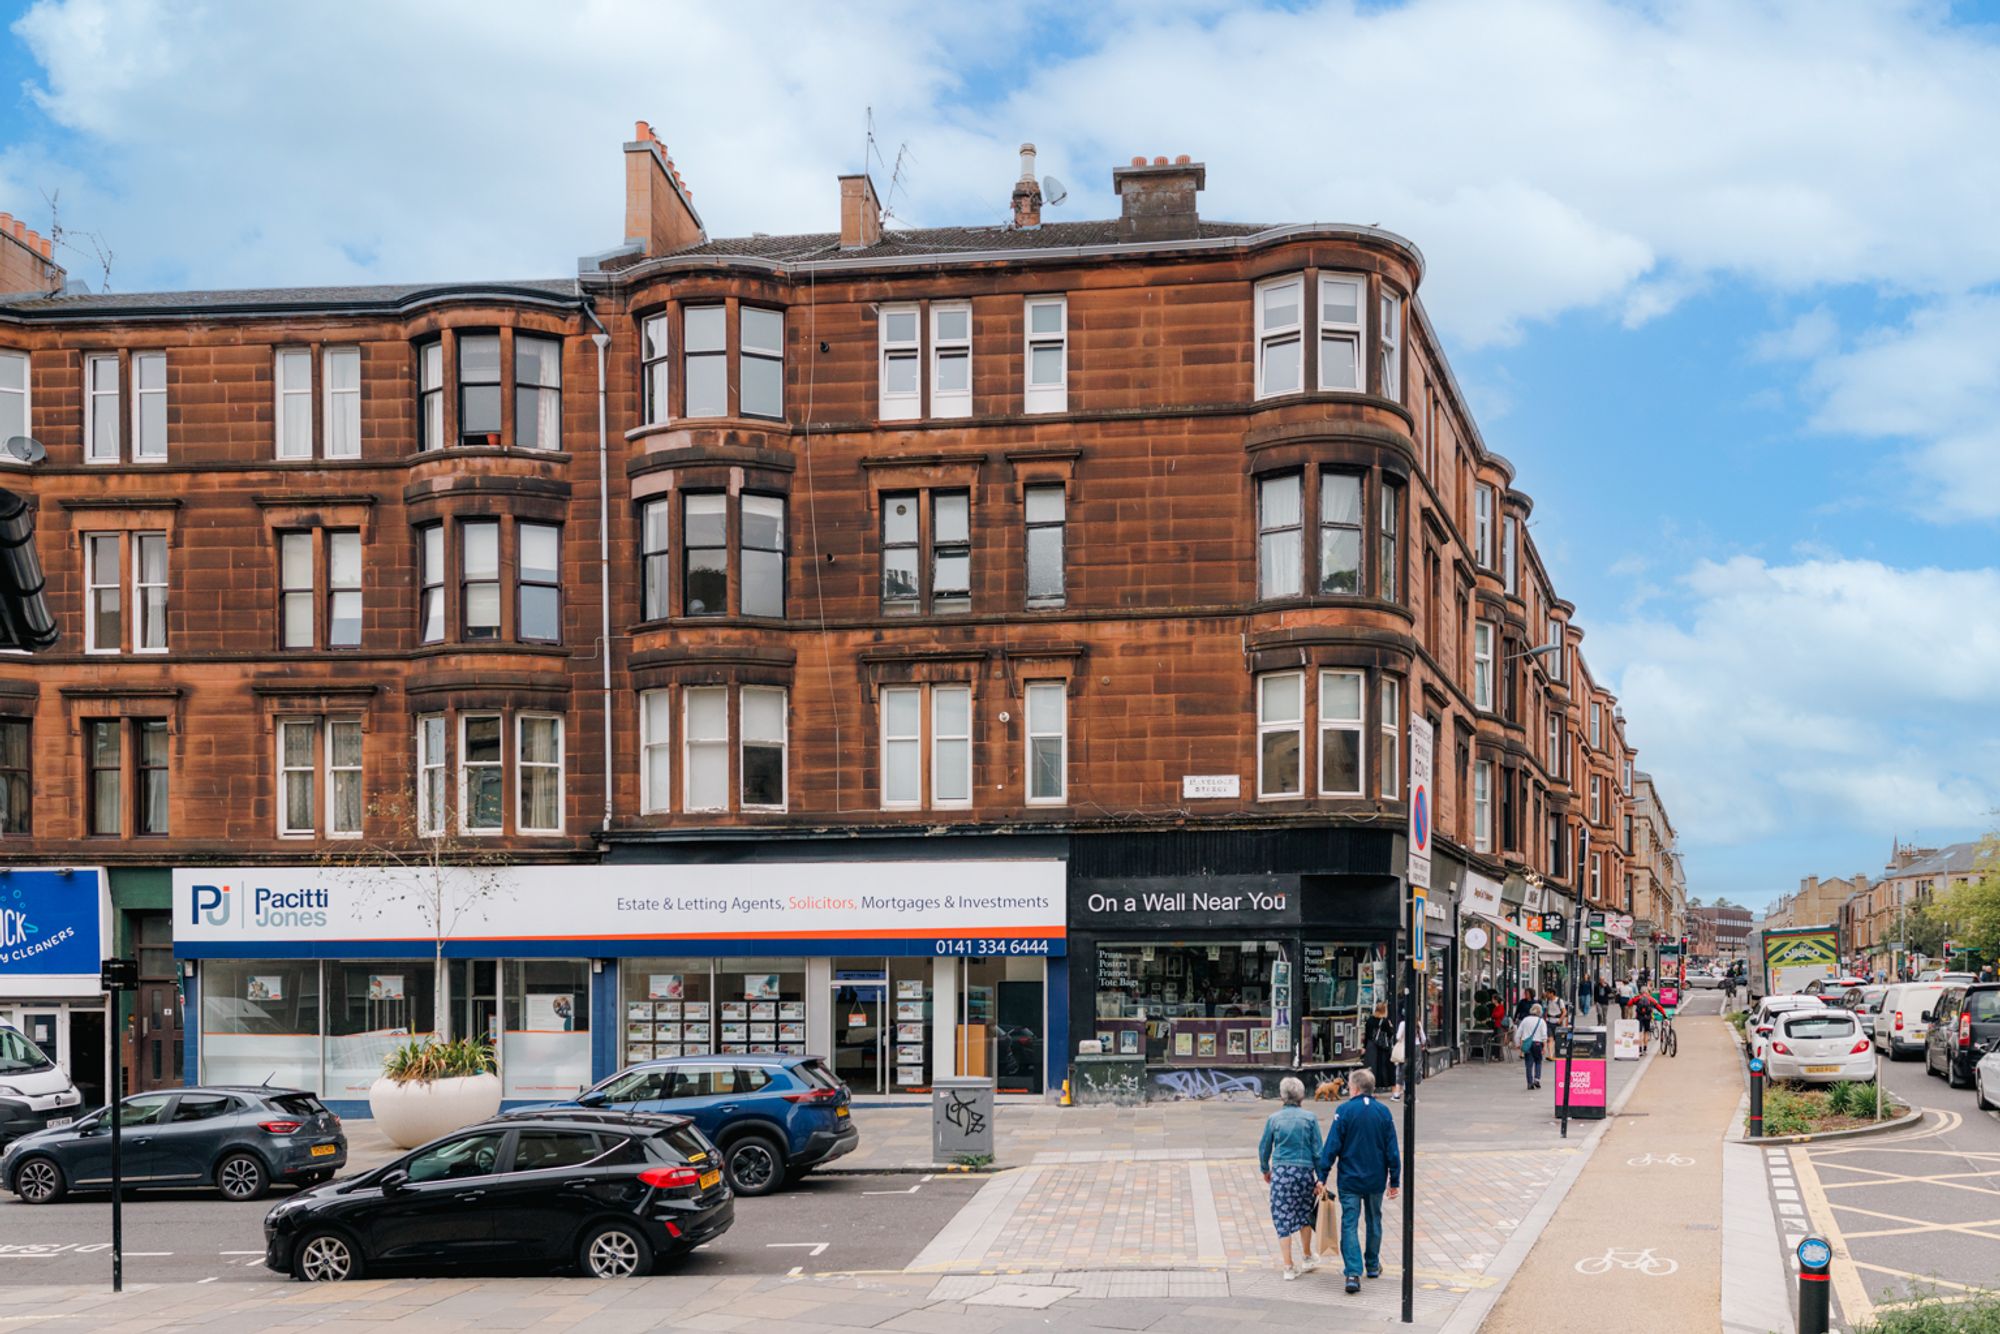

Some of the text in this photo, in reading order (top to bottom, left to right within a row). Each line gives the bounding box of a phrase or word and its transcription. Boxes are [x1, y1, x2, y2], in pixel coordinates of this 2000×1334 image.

[255, 888, 329, 915] Pacitti
[617, 895, 1049, 914] Estate & Letting Agents, Solicitors, Mortgages & Investments
[1088, 891, 1286, 913] On a Wall Near You
[255, 906, 328, 927] Jones
[12, 926, 76, 961] CLEANERS
[935, 939, 1049, 955] 0141 334 6444
[1099, 977, 1118, 987] Tote
